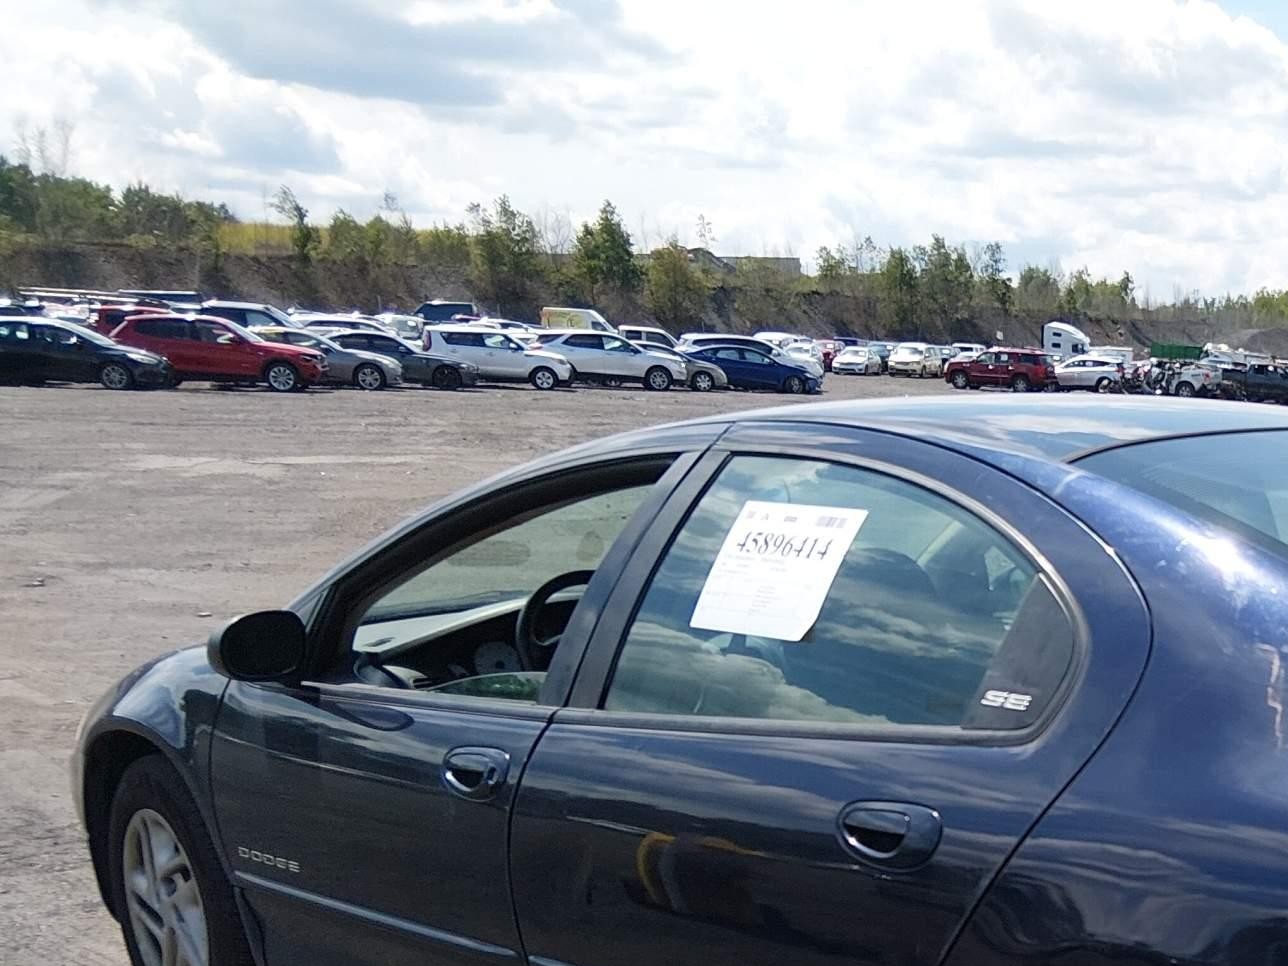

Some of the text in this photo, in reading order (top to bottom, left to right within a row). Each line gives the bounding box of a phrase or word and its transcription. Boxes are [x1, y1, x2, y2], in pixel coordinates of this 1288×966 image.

[736, 531, 833, 561] 45896414
[980, 690, 1033, 711] SE
[237, 846, 301, 873] DODGE
